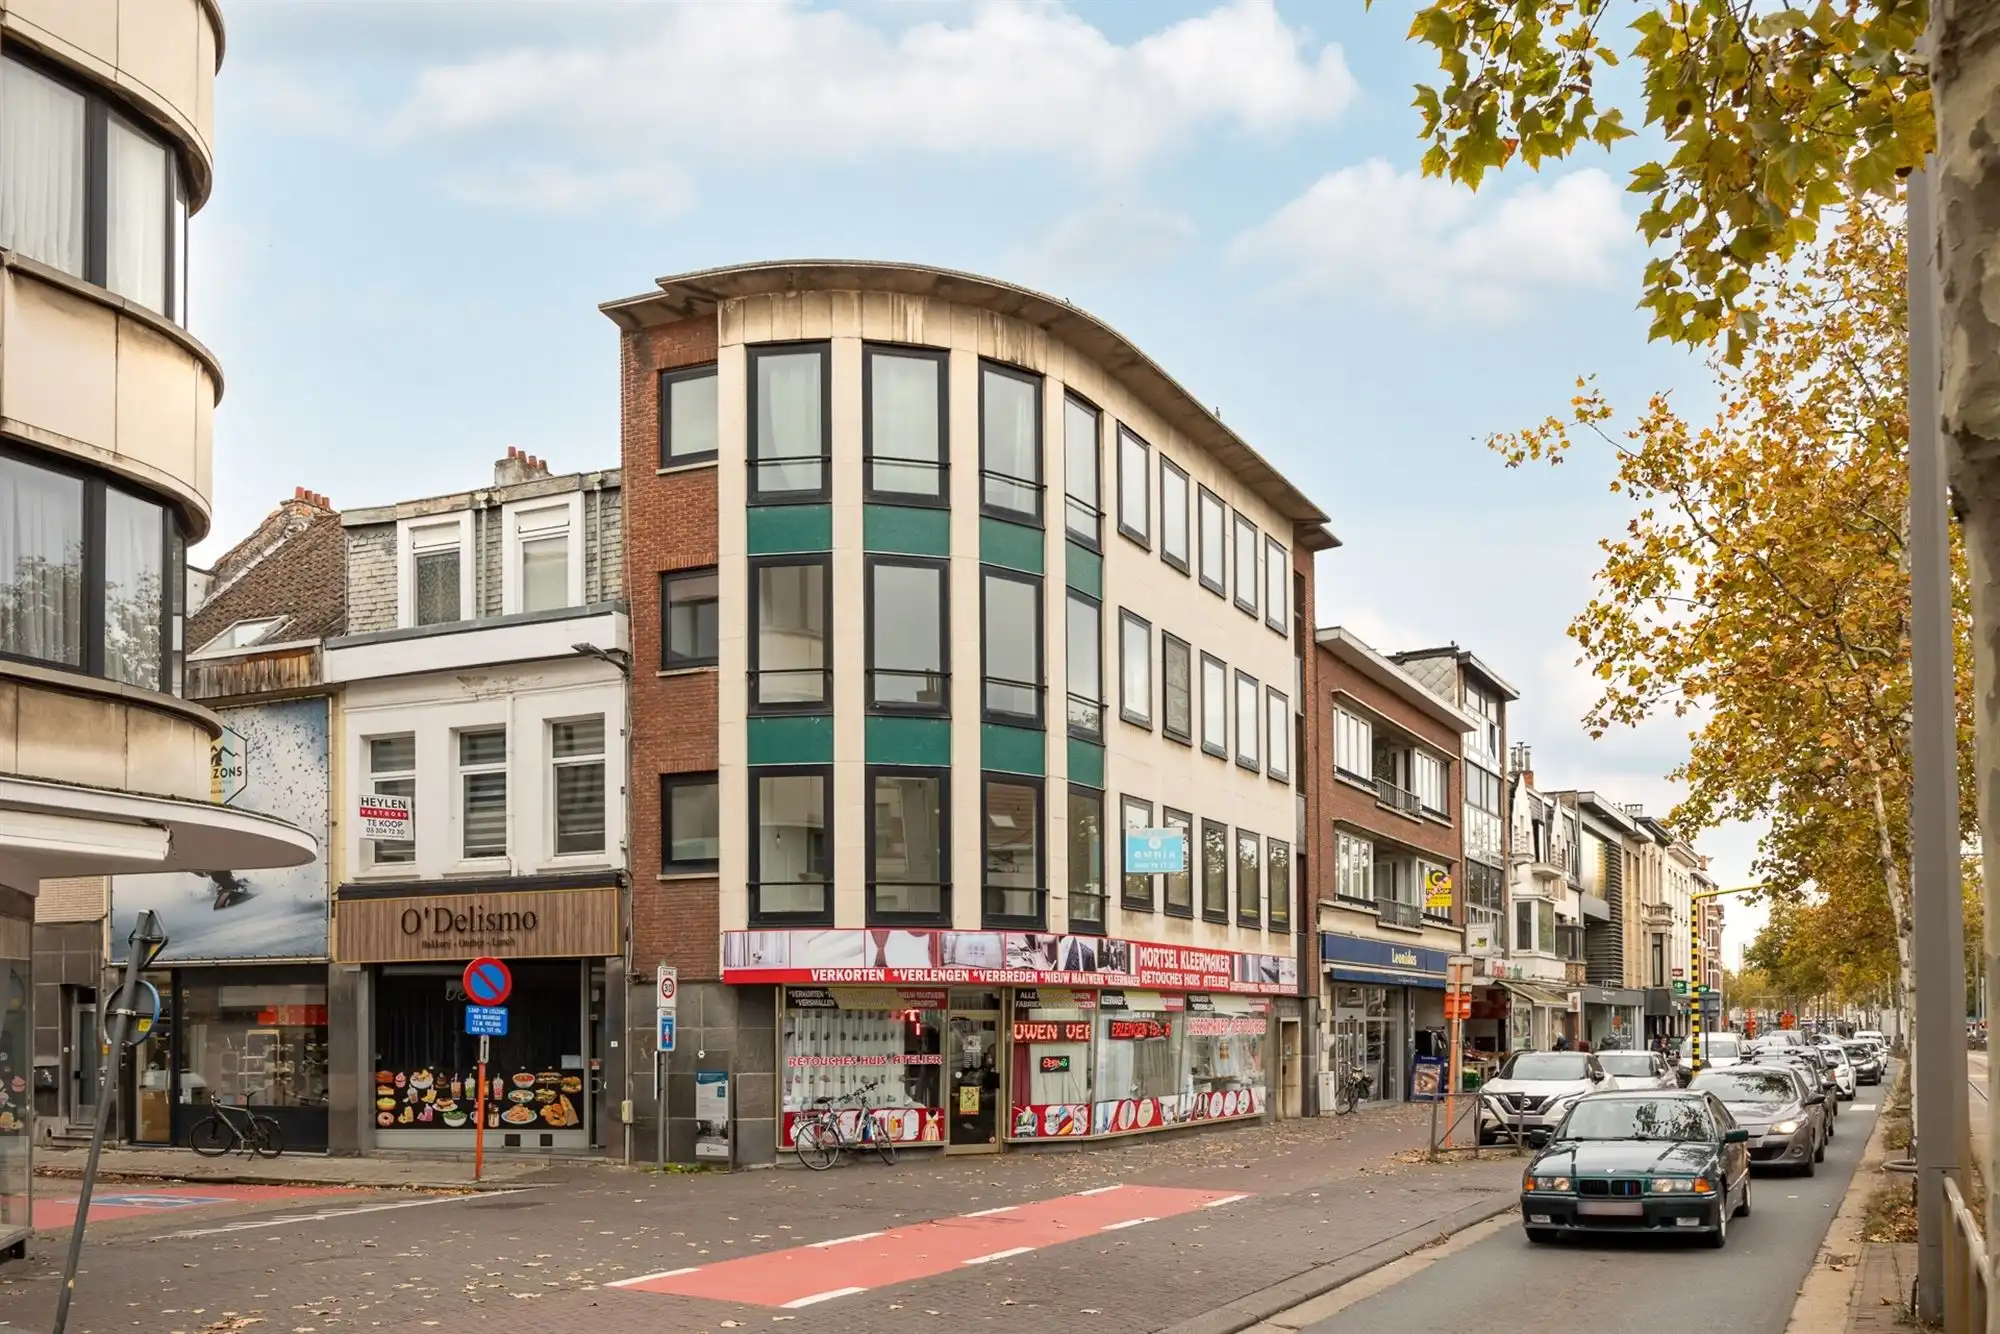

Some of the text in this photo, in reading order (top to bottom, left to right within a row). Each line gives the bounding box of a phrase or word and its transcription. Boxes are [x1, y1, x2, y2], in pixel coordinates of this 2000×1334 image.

[213, 767, 242, 778] ZONS
[361, 797, 406, 809] HEYLEN
[379, 820, 403, 828] KOOP
[401, 905, 537, 935] O'Delismo
[1140, 947, 1230, 974] MORTSEL KLEERMAKER
[811, 969, 885, 981] VERKORTEN
[1141, 971, 1182, 985] RETOUCHES
[1203, 975, 1229, 987] ATELIER
[664, 983, 672, 992] 30
[788, 1054, 942, 1067] RETOUCHES HUIS ATELIER
